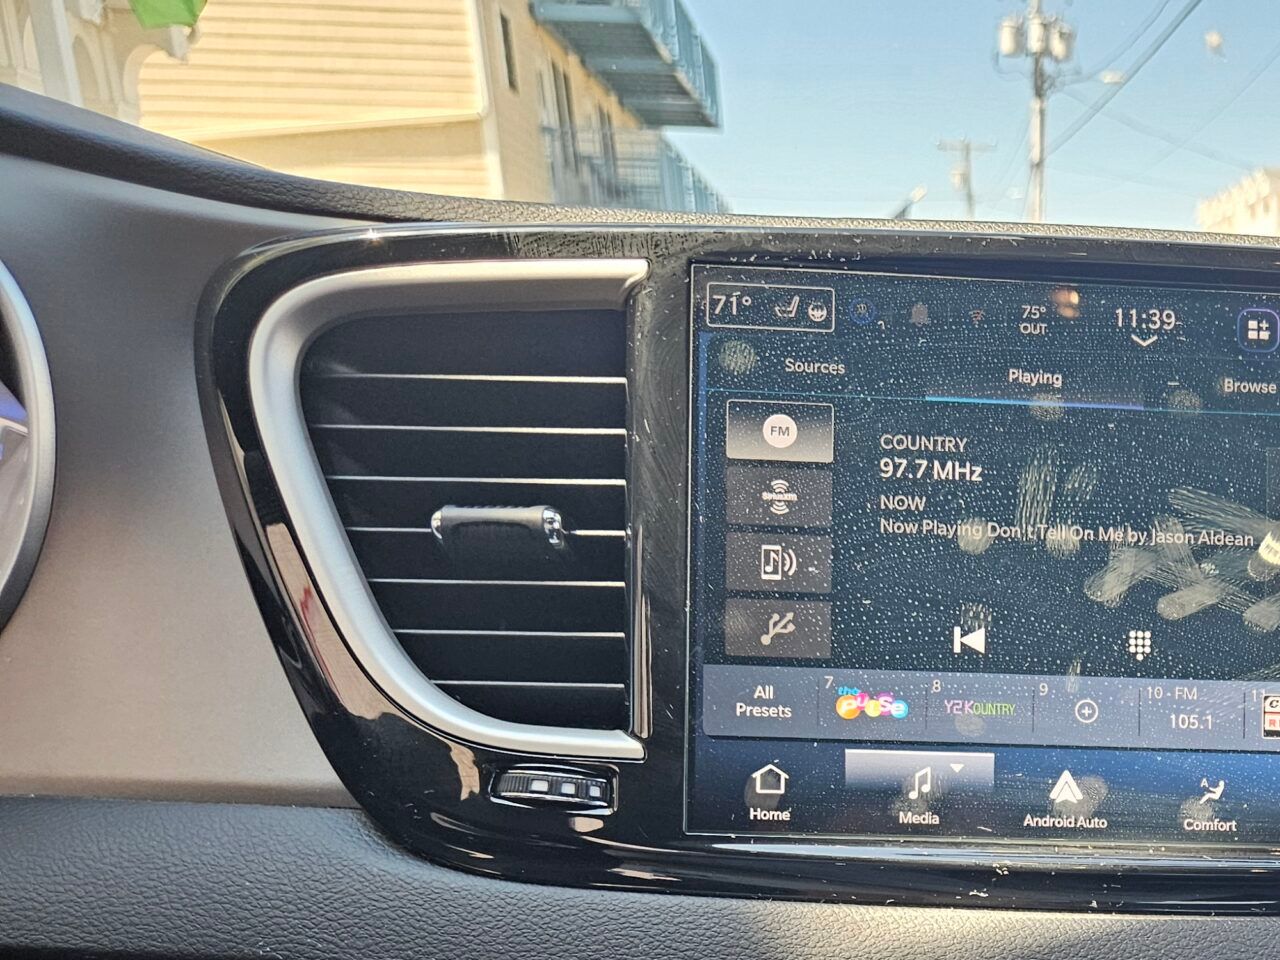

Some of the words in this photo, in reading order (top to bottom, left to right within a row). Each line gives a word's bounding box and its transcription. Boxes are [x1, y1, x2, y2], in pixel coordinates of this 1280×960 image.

[712, 294, 751, 315] 71°
[1021, 305, 1047, 319] 75°
[1114, 309, 1176, 330] 11:39
[1020, 323, 1047, 335] OUT
[785, 358, 845, 375] Sources
[1009, 368, 1062, 388] Playing
[1224, 378, 1277, 395] Browse
[770, 425, 790, 437] FM
[880, 434, 968, 453] COUNTRY
[880, 458, 927, 480] 97.7
[933, 460, 982, 481] MHz
[880, 494, 925, 511] NOW
[880, 518, 918, 534] Now
[922, 519, 982, 540] Playing
[987, 523, 1036, 539] Don't
[1037, 524, 1068, 540] Tell
[1070, 526, 1094, 541] On
[1099, 527, 1123, 542] Me
[1128, 528, 1147, 545] by
[1151, 529, 1194, 545] Jason
[1198, 530, 1254, 547] Aldean
[824, 675, 834, 689] 7
[932, 679, 941, 693] 8
[1039, 682, 1048, 696] 9
[754, 685, 775, 699] All
[1147, 686, 1163, 699] 10
[1175, 686, 1198, 700] FM
[736, 702, 792, 718] Presets
[1170, 714, 1212, 729] 105.1
[750, 807, 790, 821] Home
[899, 812, 940, 825] Media
[1024, 814, 1075, 828] Android
[1077, 815, 1108, 829] Auto
[1183, 818, 1237, 832] Comfort
